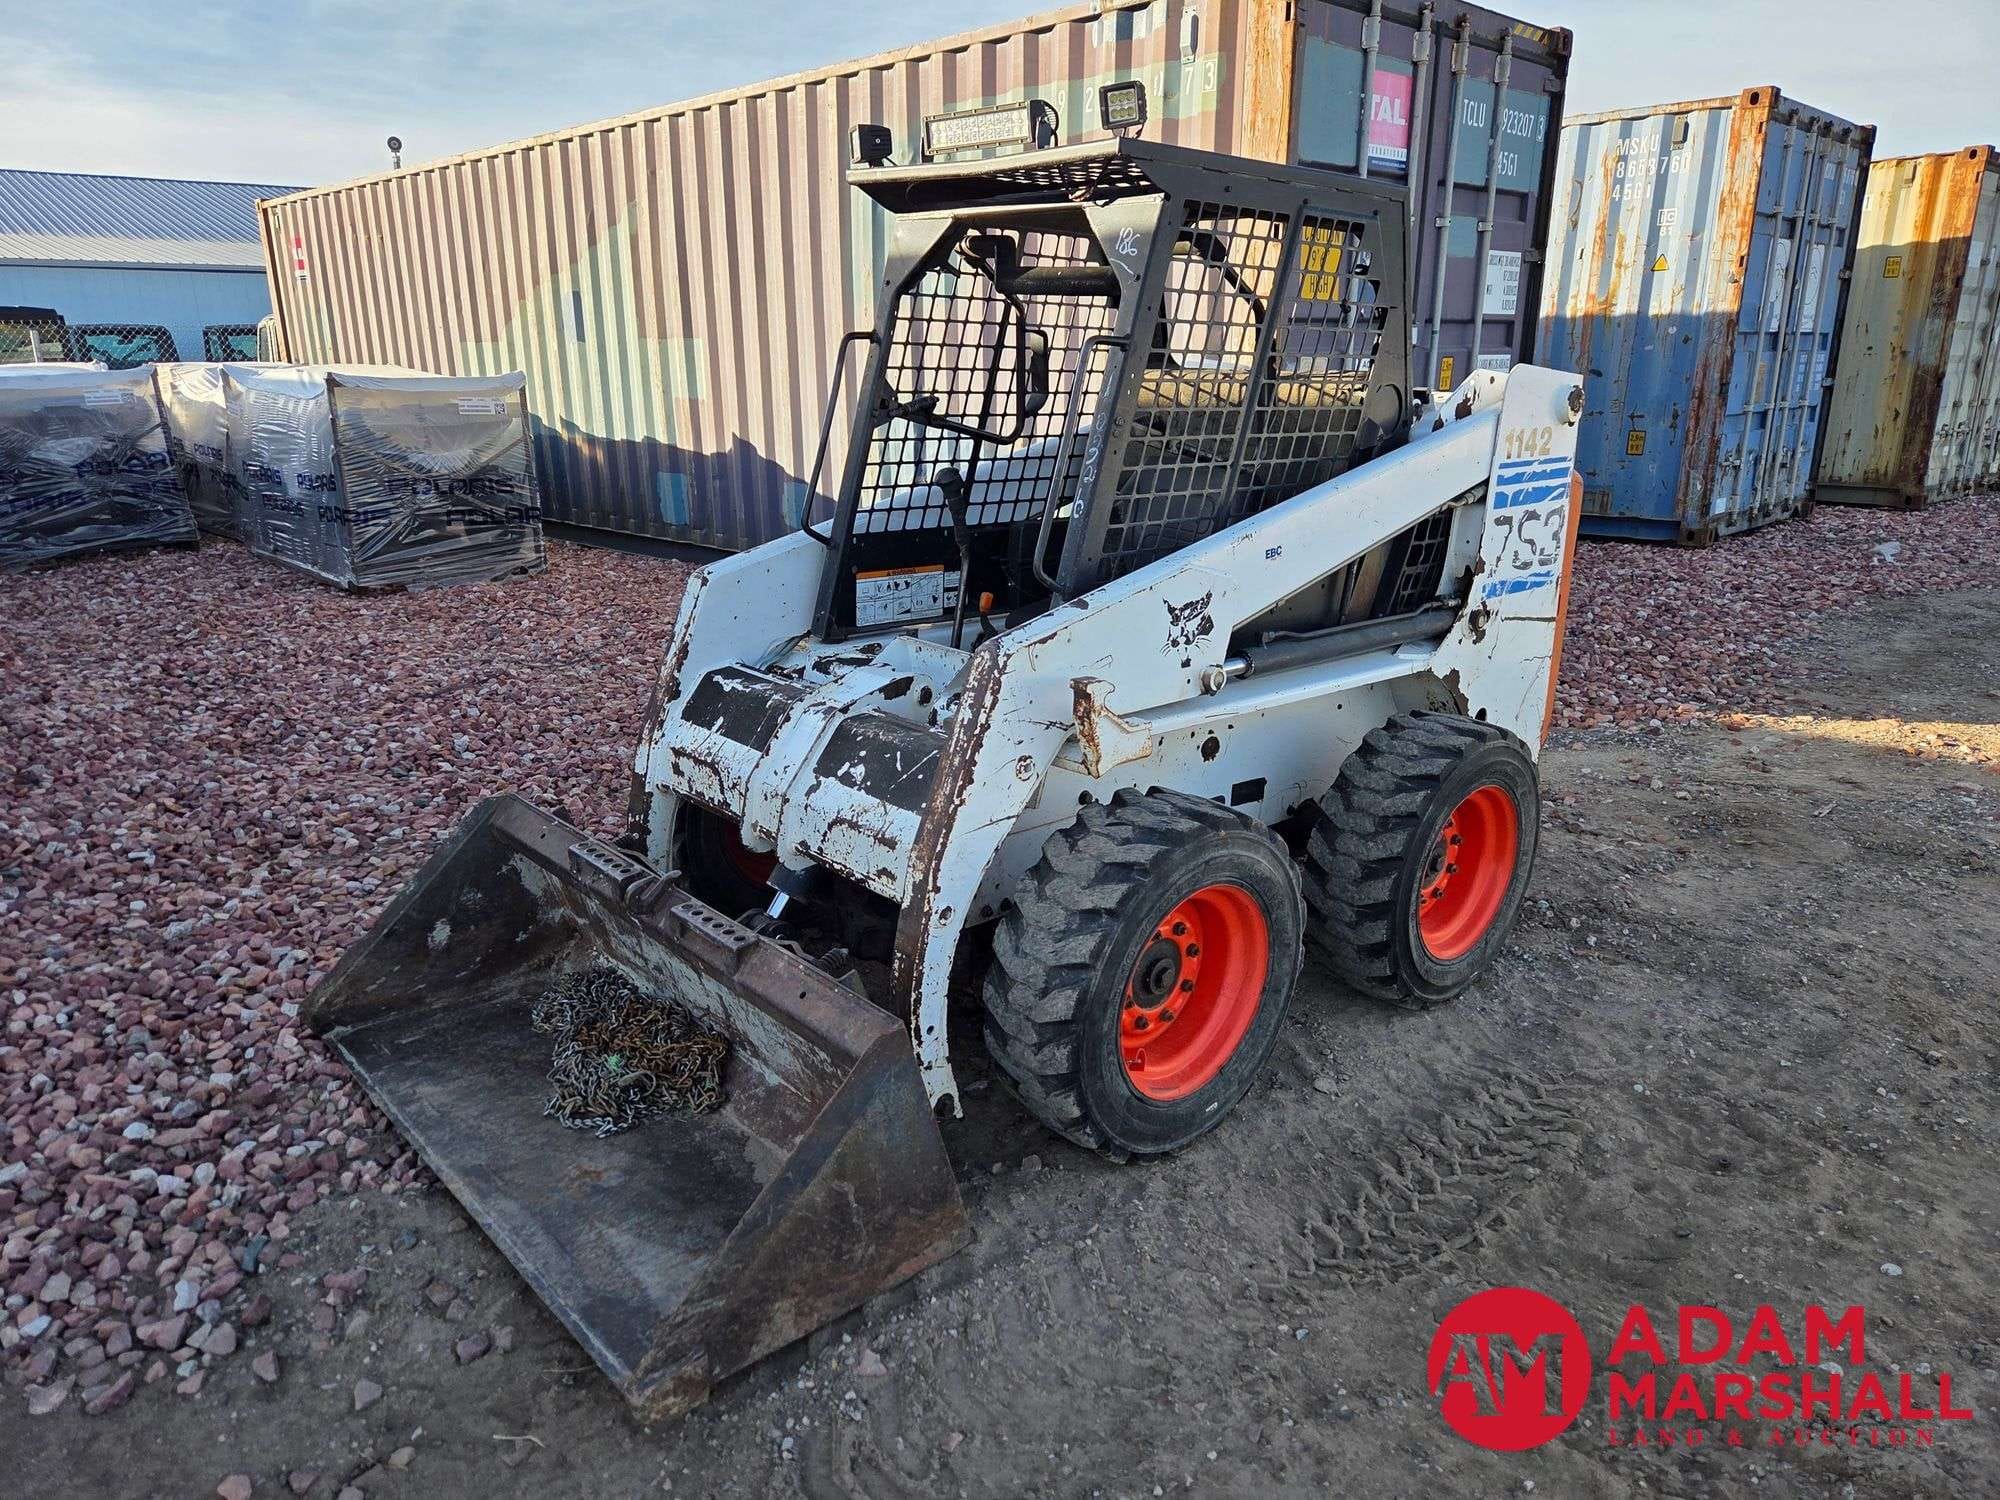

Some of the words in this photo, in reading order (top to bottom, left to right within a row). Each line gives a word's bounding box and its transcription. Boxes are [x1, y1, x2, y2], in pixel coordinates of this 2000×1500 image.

[1463, 99, 1486, 127] TCLU
[1501, 108, 1534, 138] 923207
[1616, 134, 1659, 155] MSKU
[1505, 426, 1552, 459] 1142
[1265, 545, 1282, 559] EBC
[1490, 505, 1565, 578] 753
